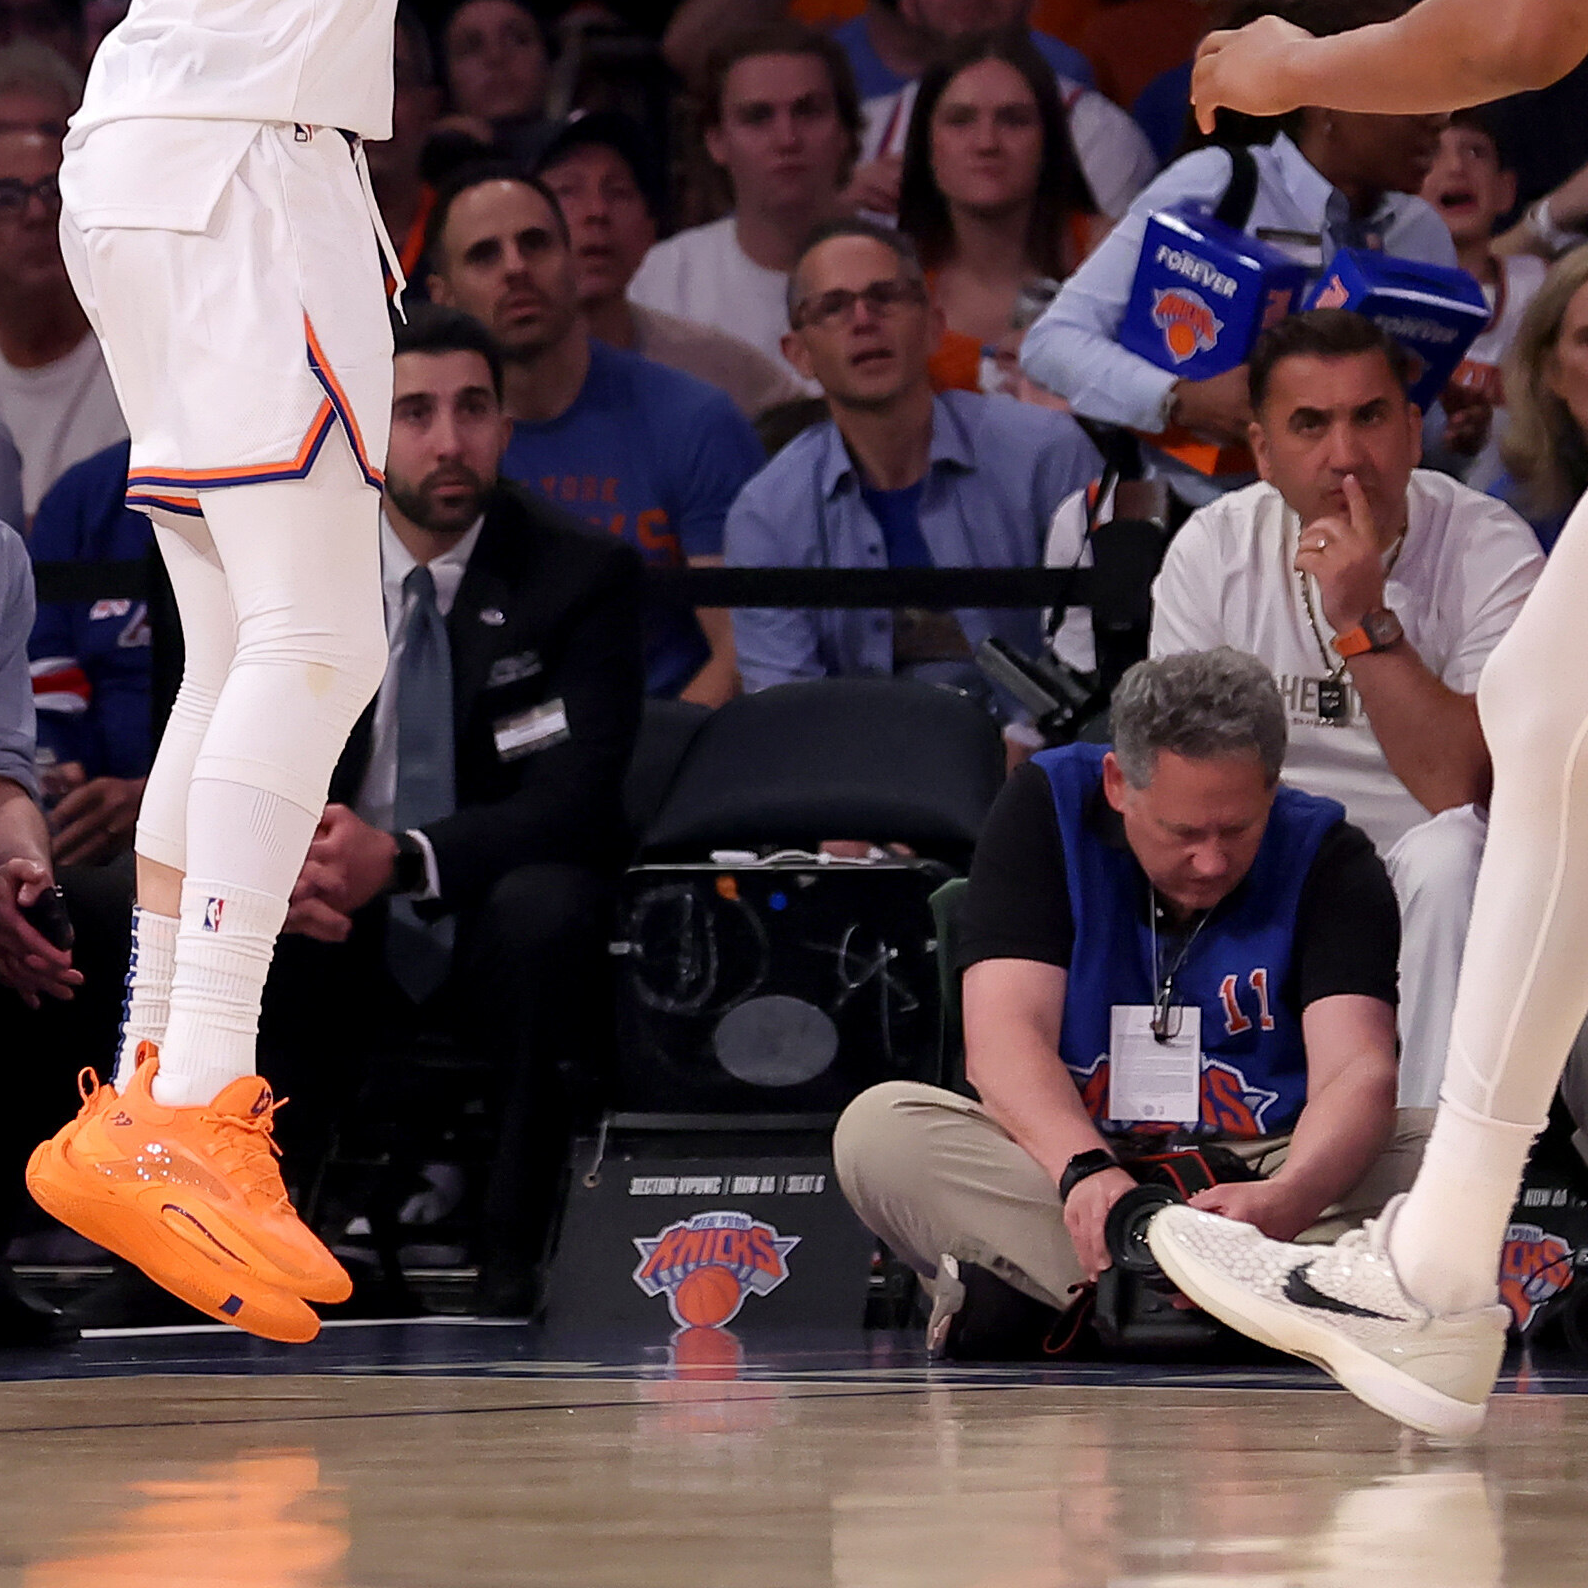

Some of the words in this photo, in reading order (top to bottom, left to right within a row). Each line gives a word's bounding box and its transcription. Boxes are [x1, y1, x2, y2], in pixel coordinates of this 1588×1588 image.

[1154, 243, 1239, 300] FOREVER
[1218, 967, 1276, 1036] 11
[639, 1226, 782, 1279] KNICKS
